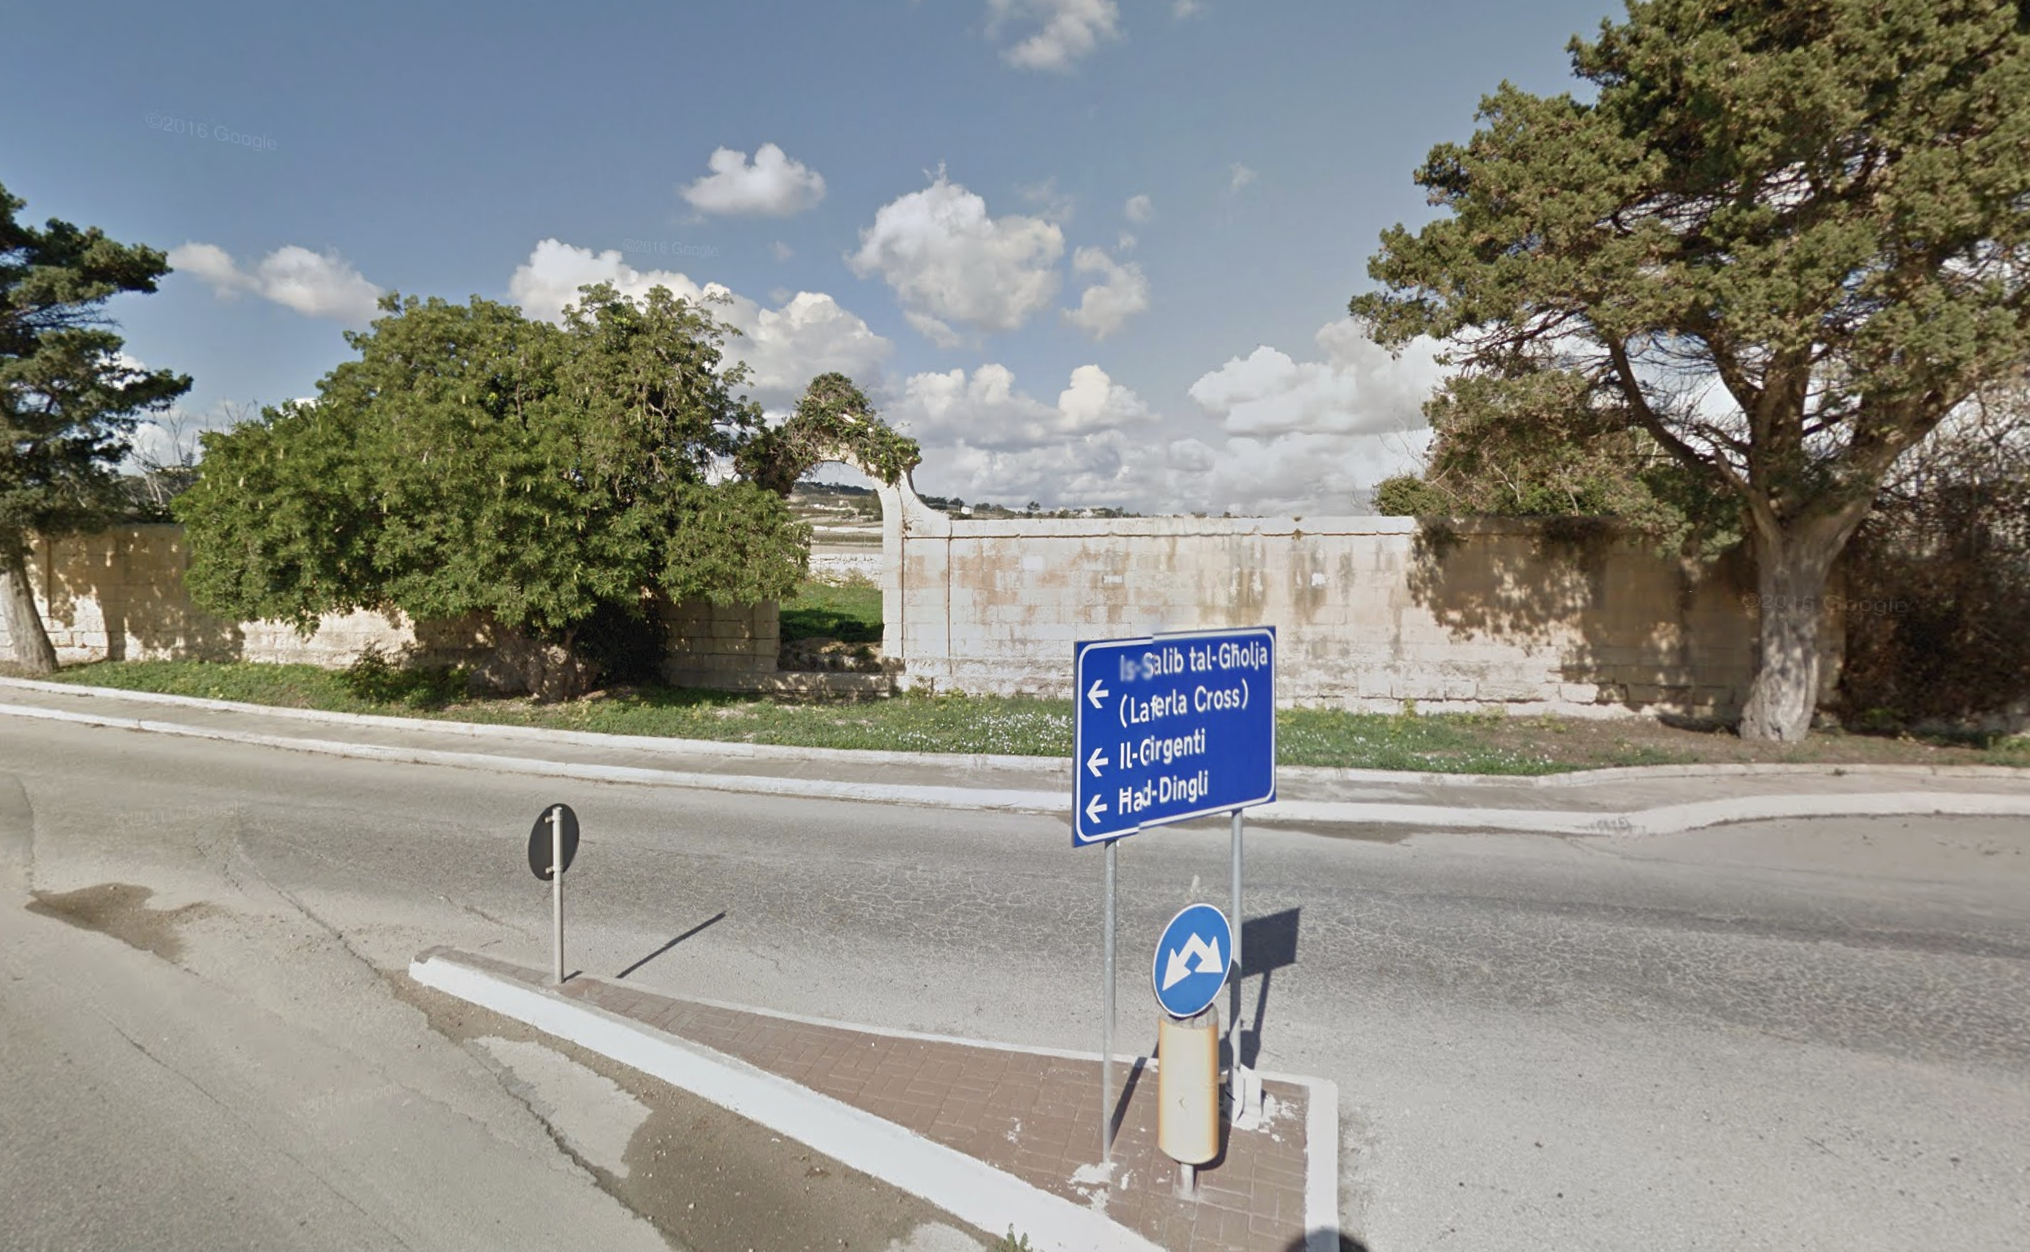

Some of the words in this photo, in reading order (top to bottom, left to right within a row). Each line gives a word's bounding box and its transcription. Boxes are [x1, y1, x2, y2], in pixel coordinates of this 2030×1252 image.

[1119, 689, 1187, 728] (Laferla
[1194, 678, 1249, 713] Cross)
[1120, 727, 1206, 770] Il-Girgenti
